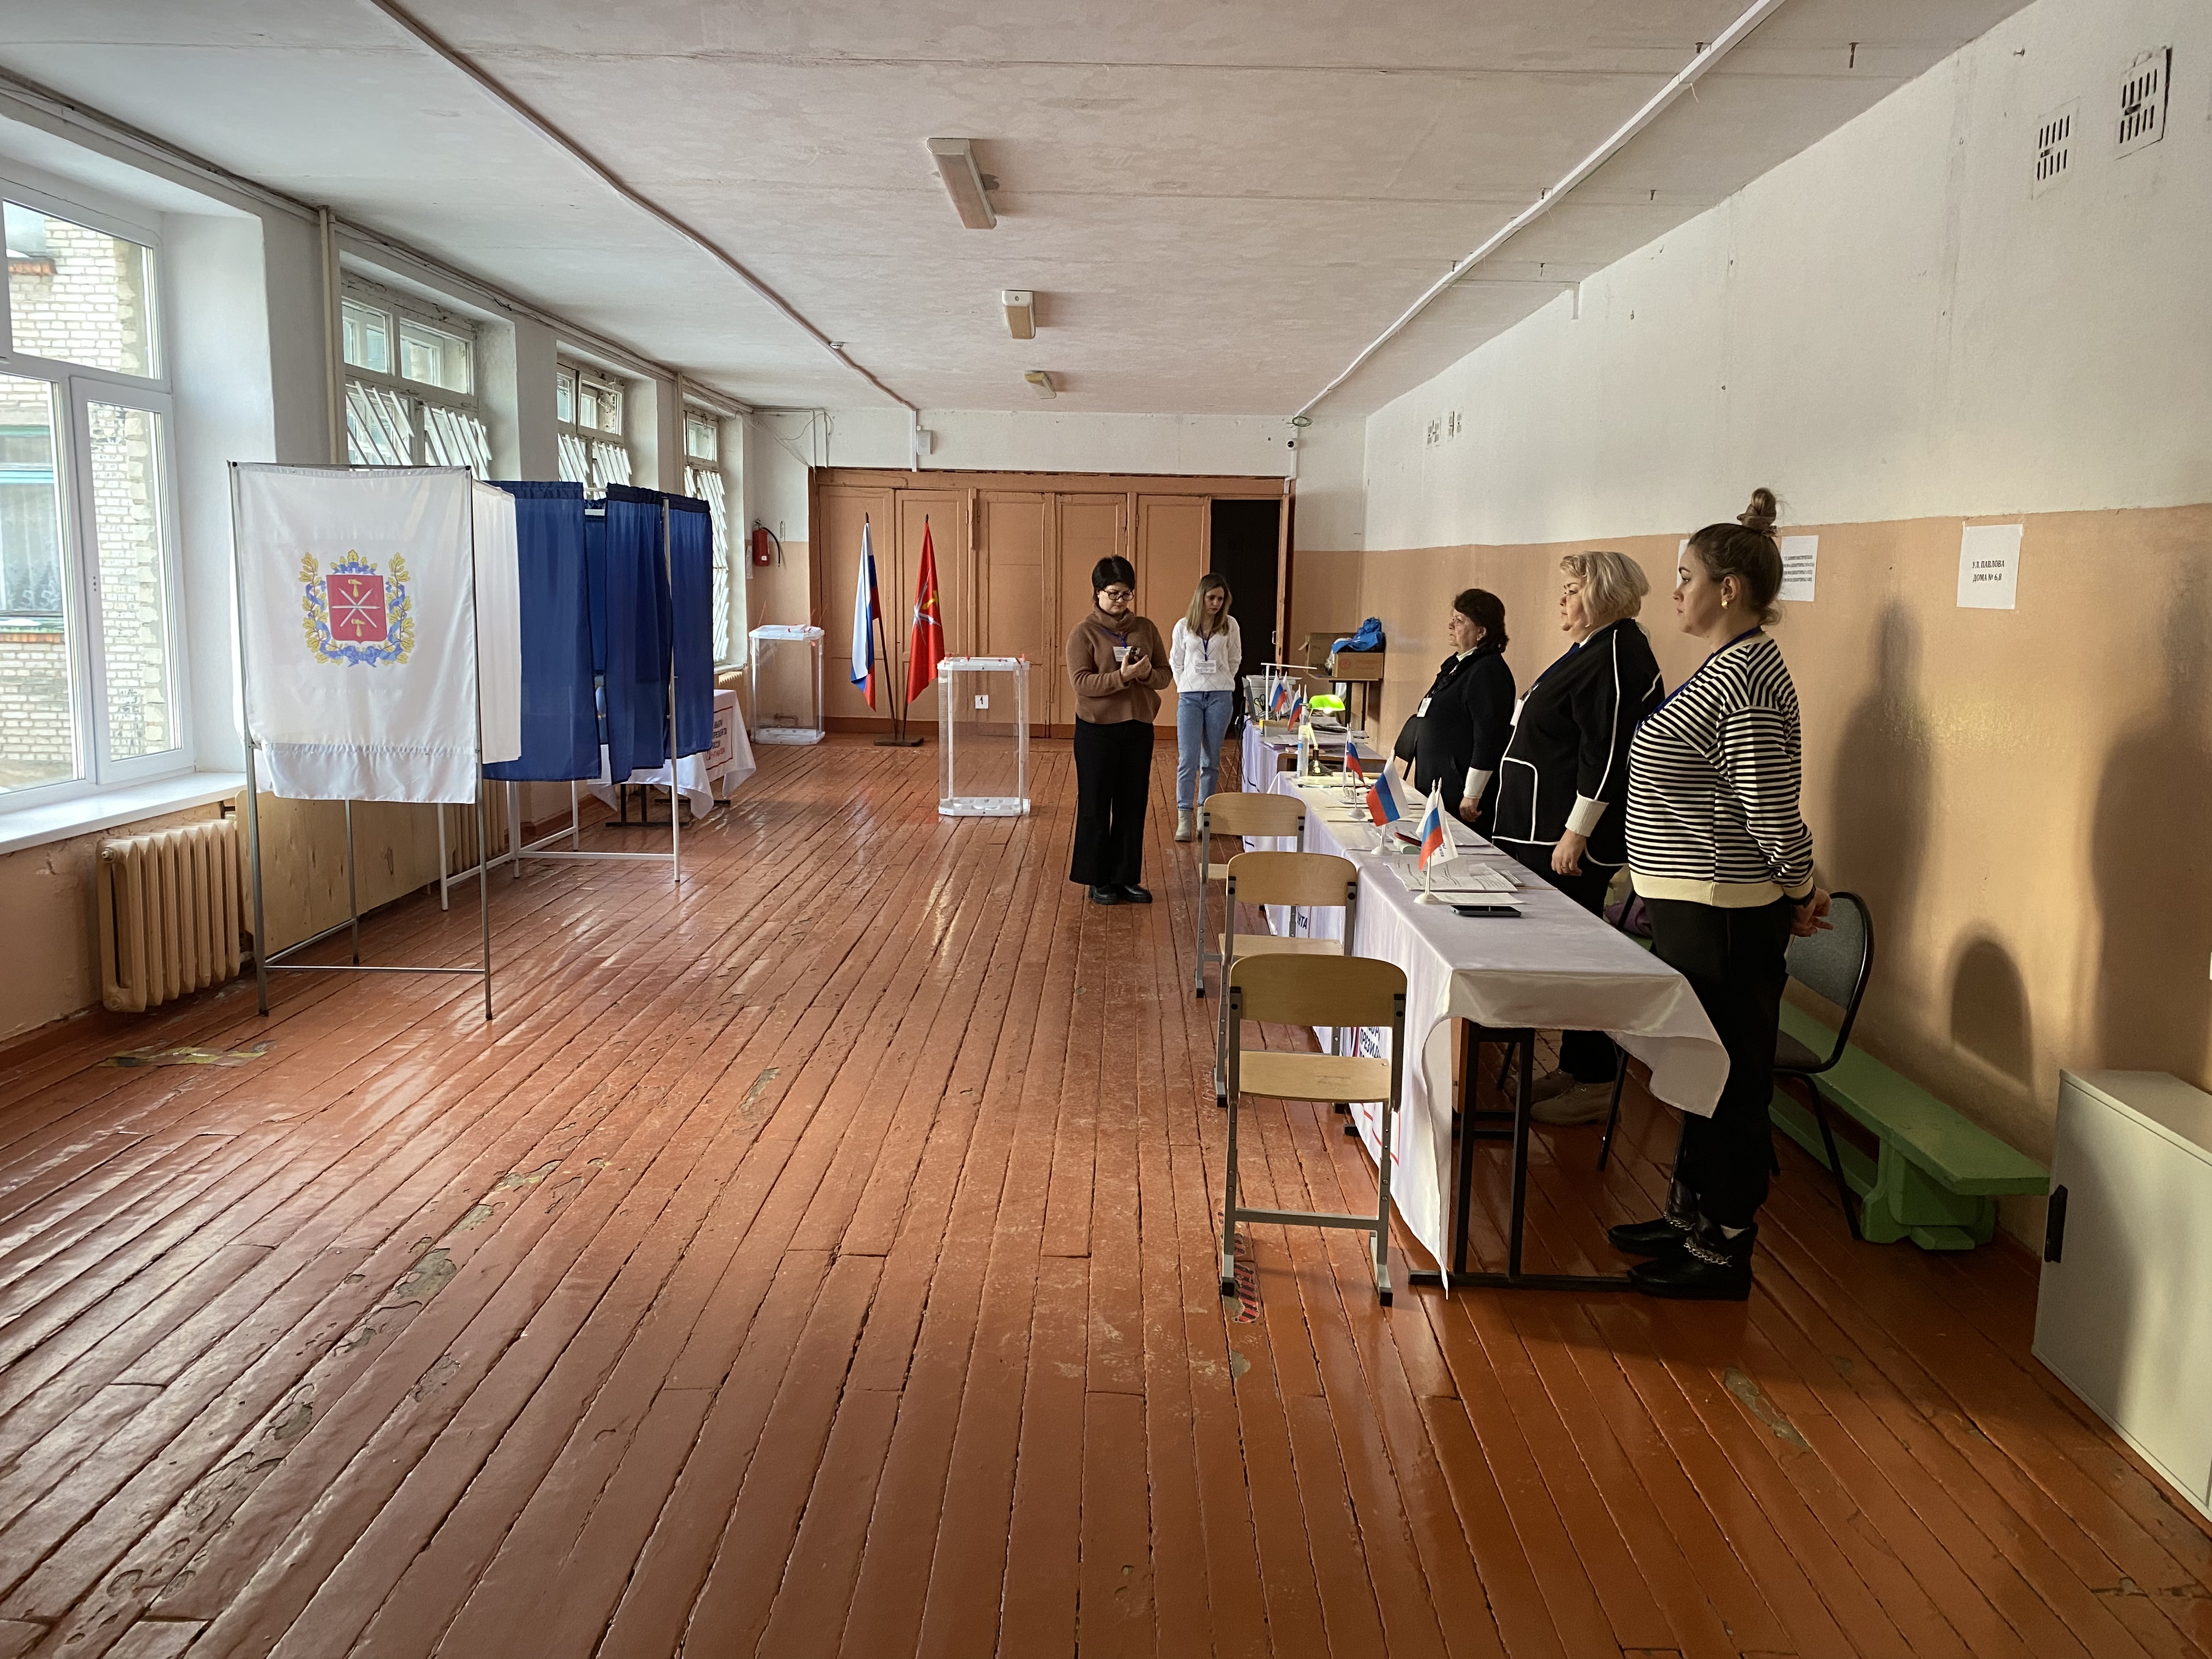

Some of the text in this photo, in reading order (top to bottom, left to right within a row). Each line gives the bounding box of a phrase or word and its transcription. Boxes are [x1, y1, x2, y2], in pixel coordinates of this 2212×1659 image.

[1973, 574, 1987, 583] ДОМА
[979, 696, 983, 704] 1
[1361, 1028, 1381, 1058] ПРЕЗИД
